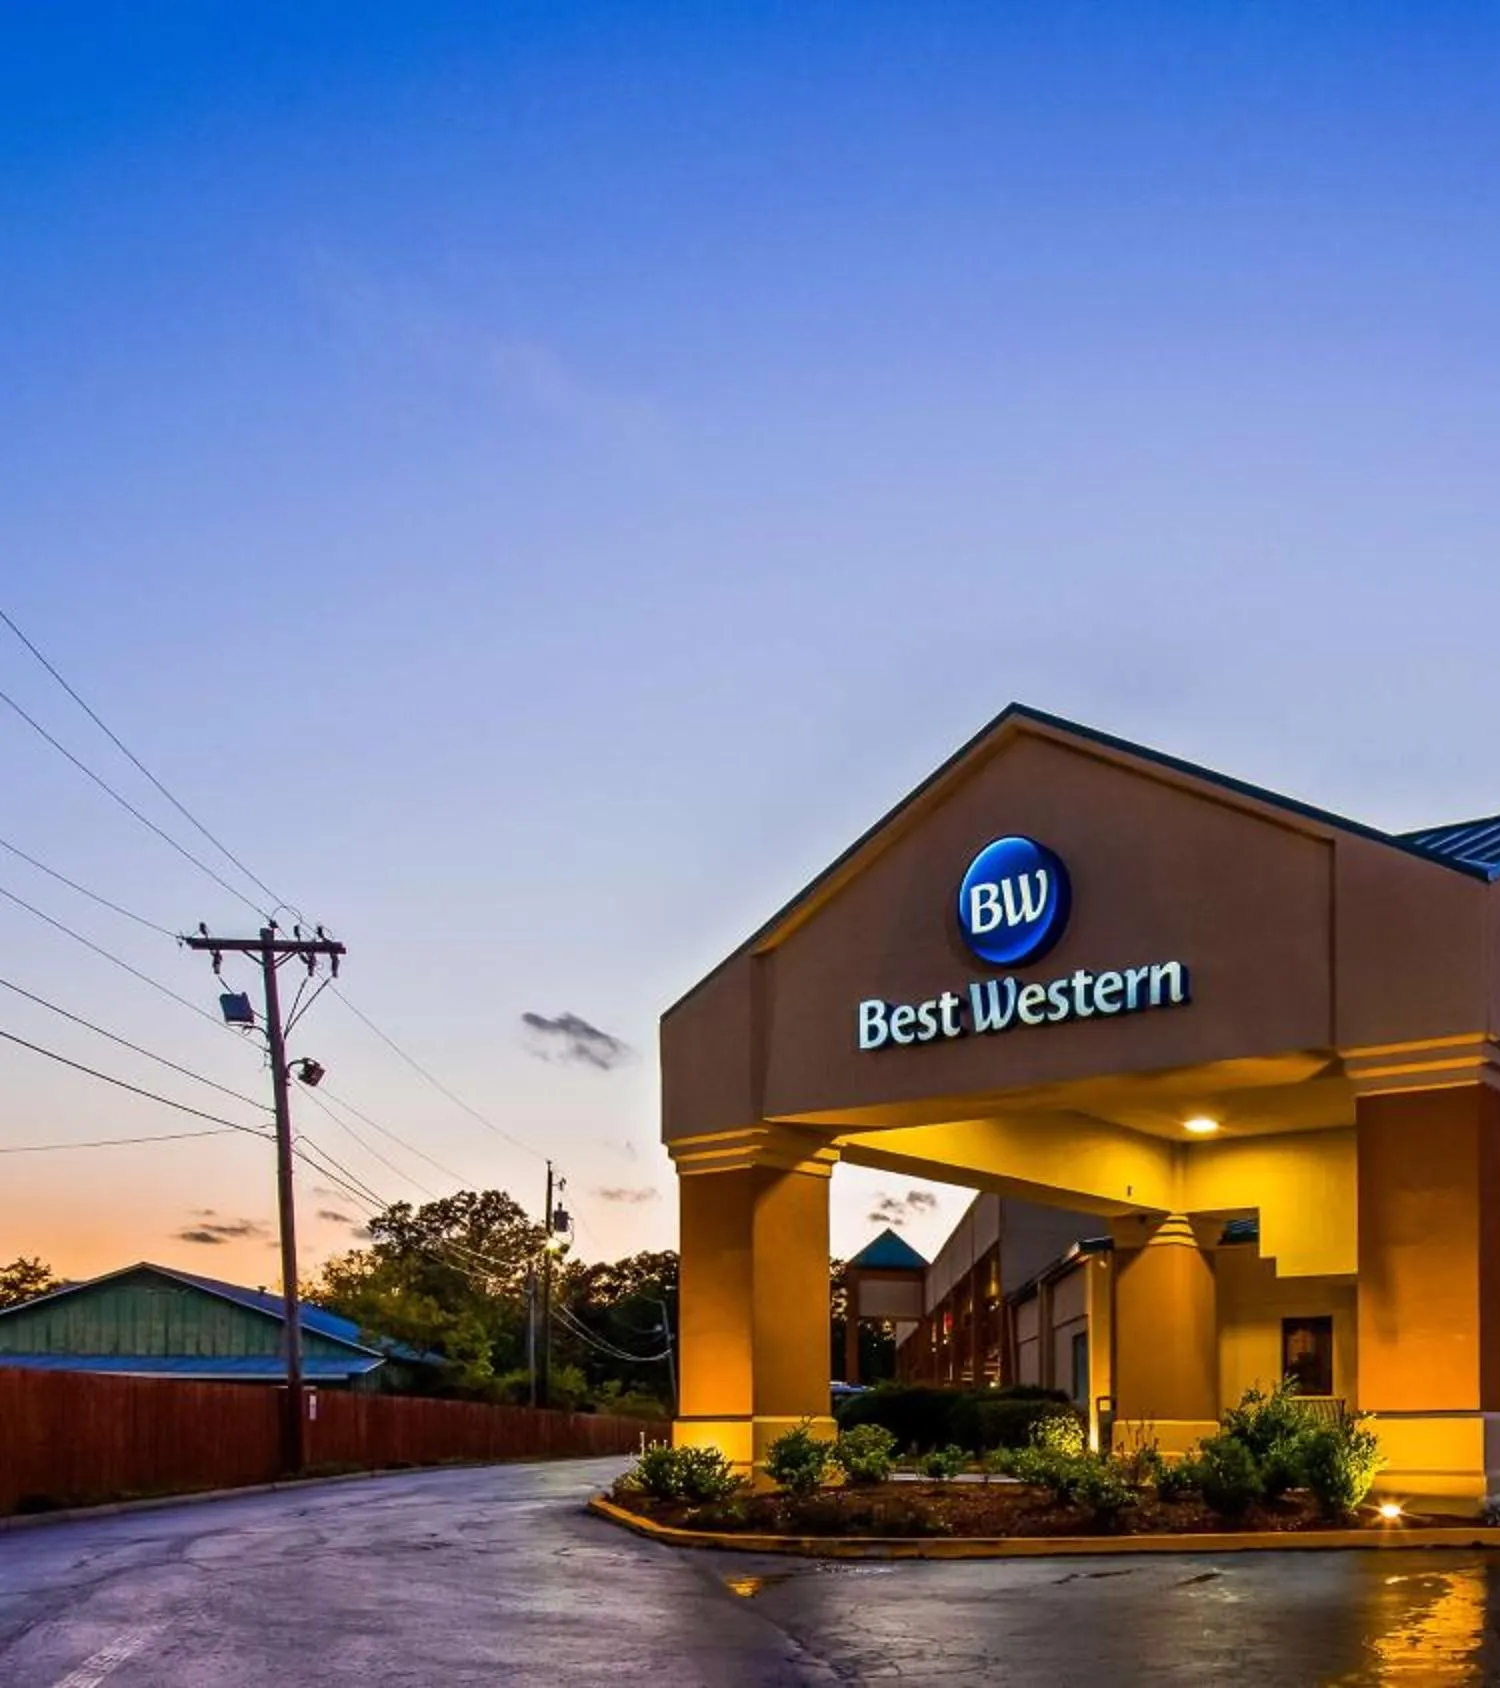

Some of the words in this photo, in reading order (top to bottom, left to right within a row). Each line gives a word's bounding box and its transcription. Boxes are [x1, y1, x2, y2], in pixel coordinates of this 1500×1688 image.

[969, 869, 1048, 934] BW
[859, 991, 961, 1050] Best
[969, 960, 1184, 1034] Western
